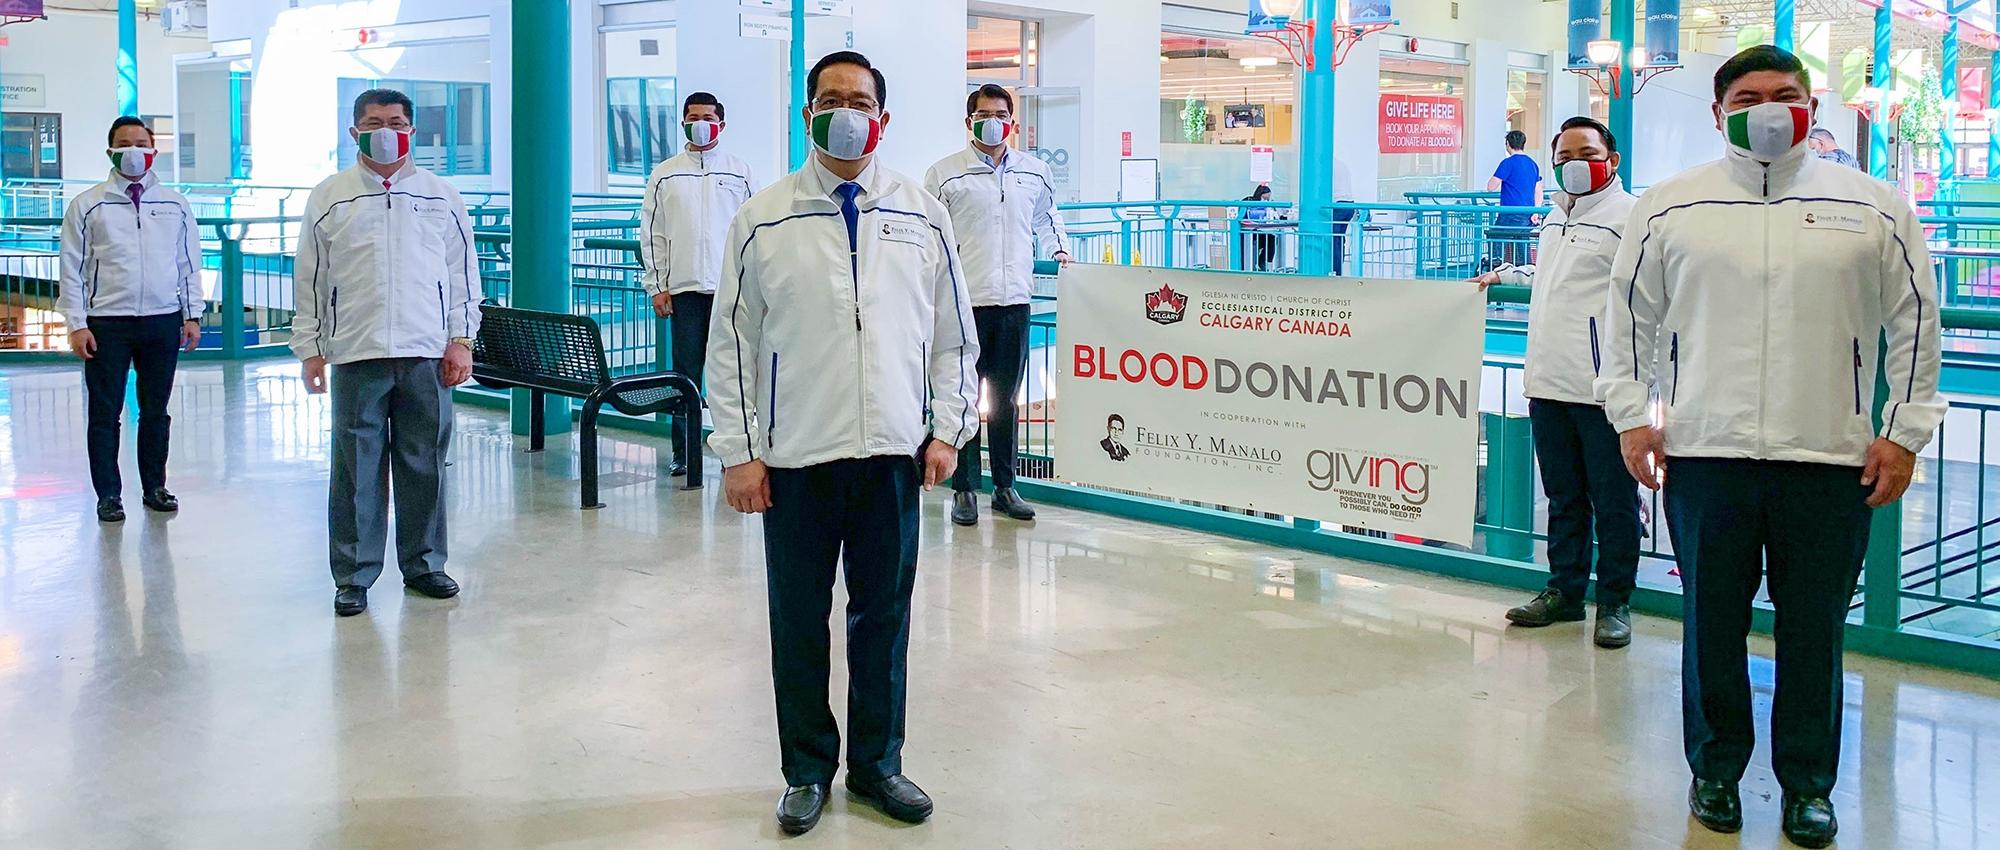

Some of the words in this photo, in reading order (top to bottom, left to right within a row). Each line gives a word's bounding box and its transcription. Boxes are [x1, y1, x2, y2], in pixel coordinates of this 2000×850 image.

[1386, 101, 1409, 118] GIVE
[1410, 102, 1429, 118] LIFE
[1430, 103, 1455, 119] HERE!
[1385, 123, 1404, 134] BOOK
[1404, 123, 1420, 134] YOUR
[1420, 124, 1457, 135] APPOINTMENT
[1388, 136, 1397, 147] TO
[1397, 136, 1420, 147] DONATE
[1420, 137, 1428, 147] AT
[1202, 291, 1228, 299] IGLESIA
[1241, 293, 1267, 301] CRISTO
[1277, 295, 1309, 304] CHURCH
[1311, 297, 1322, 305] OF
[1325, 298, 1352, 307] CHRIST
[1150, 312, 1180, 321] CALGARY
[1201, 301, 1283, 315] ECCLESIASTICAL
[1288, 307, 1334, 319] DISTRICT
[1338, 310, 1352, 320] OF
[1199, 312, 1274, 332] CALGARY
[1278, 318, 1352, 338] CANADA
[1073, 344, 1209, 391] BLOOD
[1213, 358, 1468, 419] DONATION
[1213, 412, 1280, 427] COOPERATION
[1284, 421, 1306, 429] WITH
[1186, 432, 1202, 451] Y.
[1306, 449, 1430, 505] giving
[1340, 495, 1371, 507] POSSIBLY
[1389, 502, 1400, 510] DO
[1401, 504, 1422, 514] GOOD
[1378, 494, 1392, 503] YOU
[1349, 503, 1371, 513] THOSE
[1371, 507, 1388, 515] WHO
[1389, 509, 1408, 519] NEED
